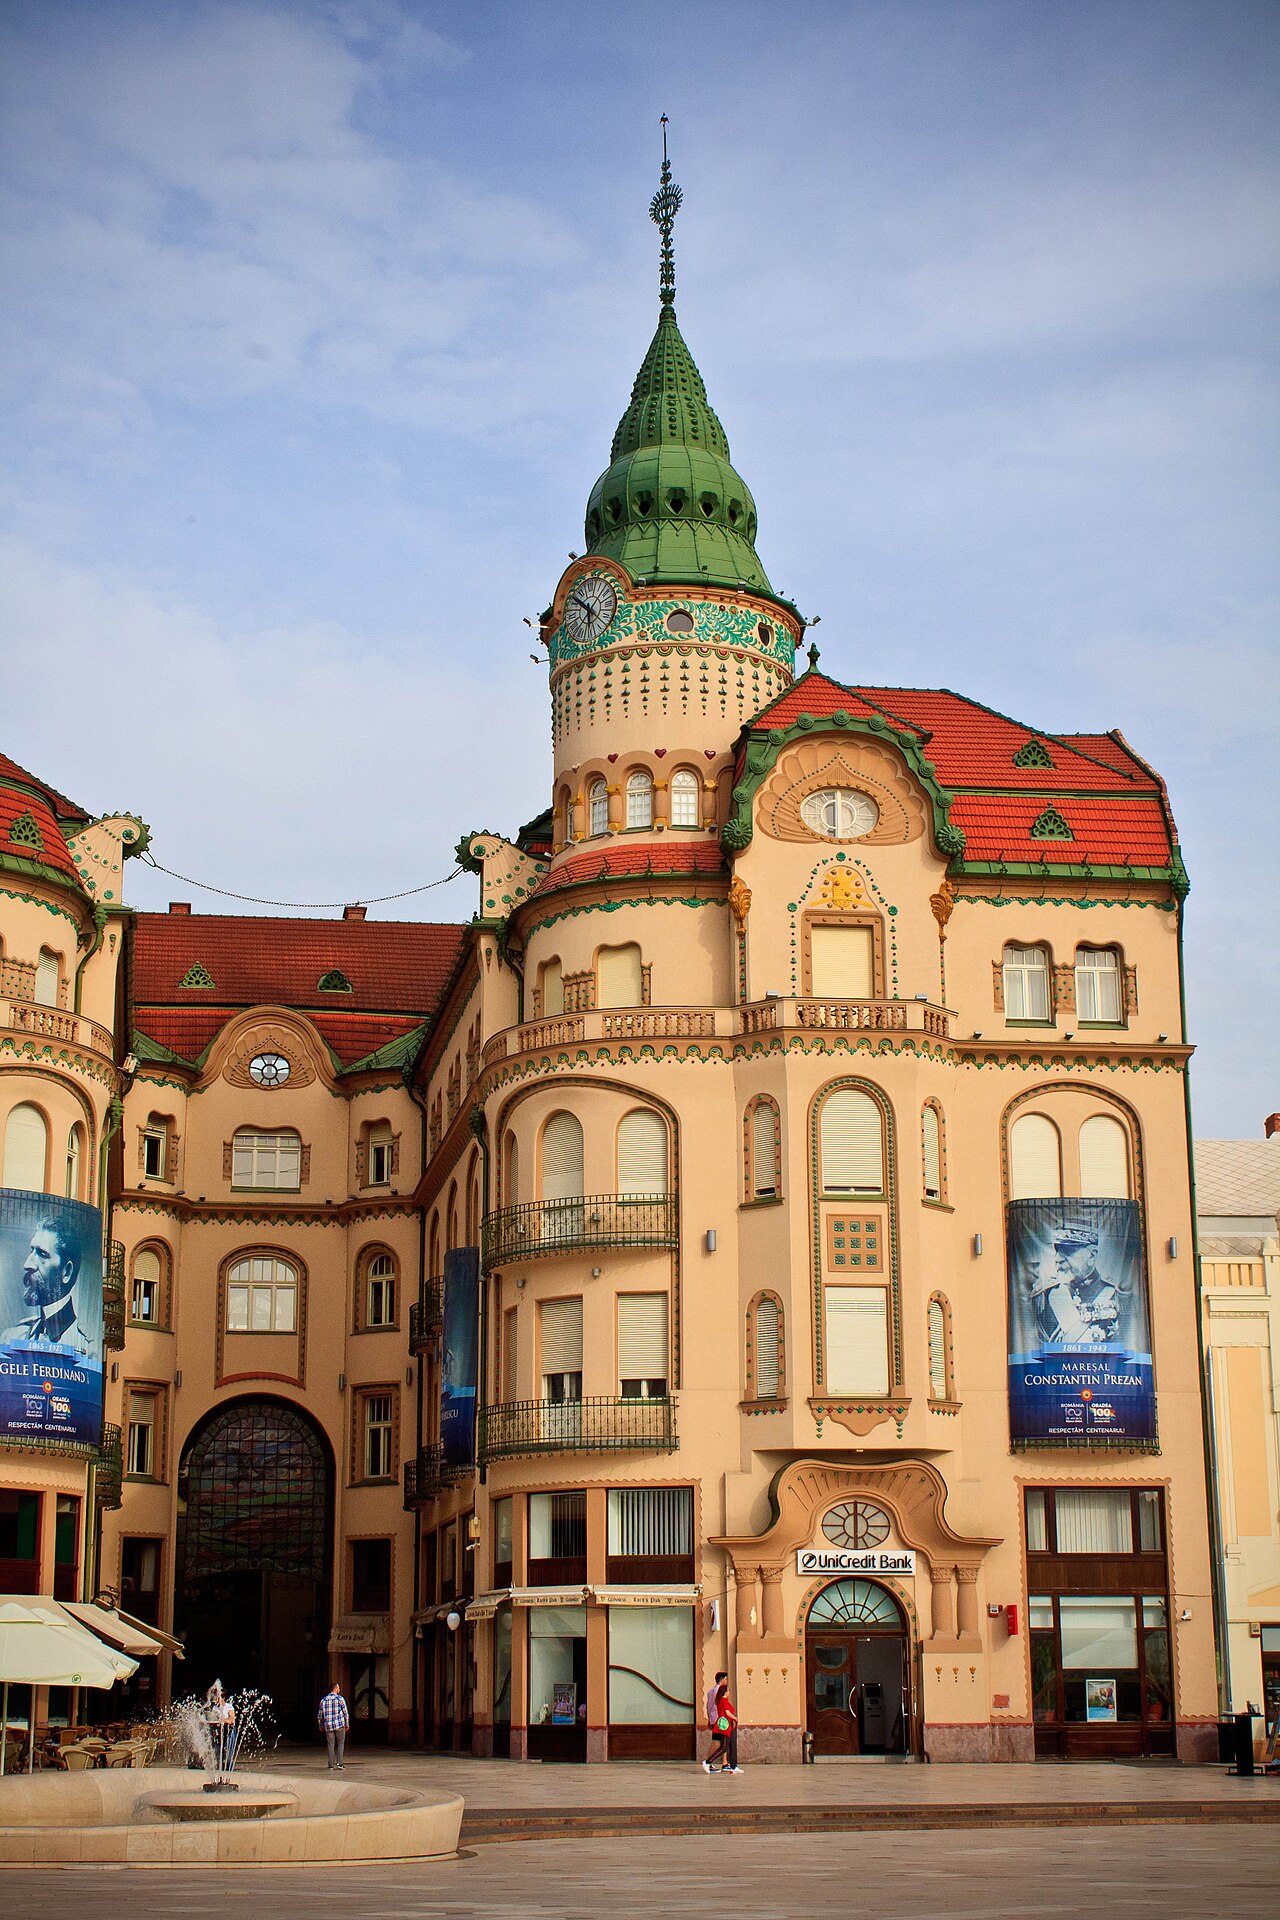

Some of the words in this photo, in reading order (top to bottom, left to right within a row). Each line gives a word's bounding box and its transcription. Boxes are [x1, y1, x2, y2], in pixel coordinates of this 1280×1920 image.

[32, 1363, 86, 1383] FERDINAND
[1024, 1374, 1100, 1386] CONSTANTIN
[1104, 1374, 1142, 1386] PREZAN
[53, 1402, 68, 1412] 100
[1093, 1408, 1110, 1417] 100
[819, 1554, 877, 1569] UniCredit
[880, 1554, 913, 1569] Bank
